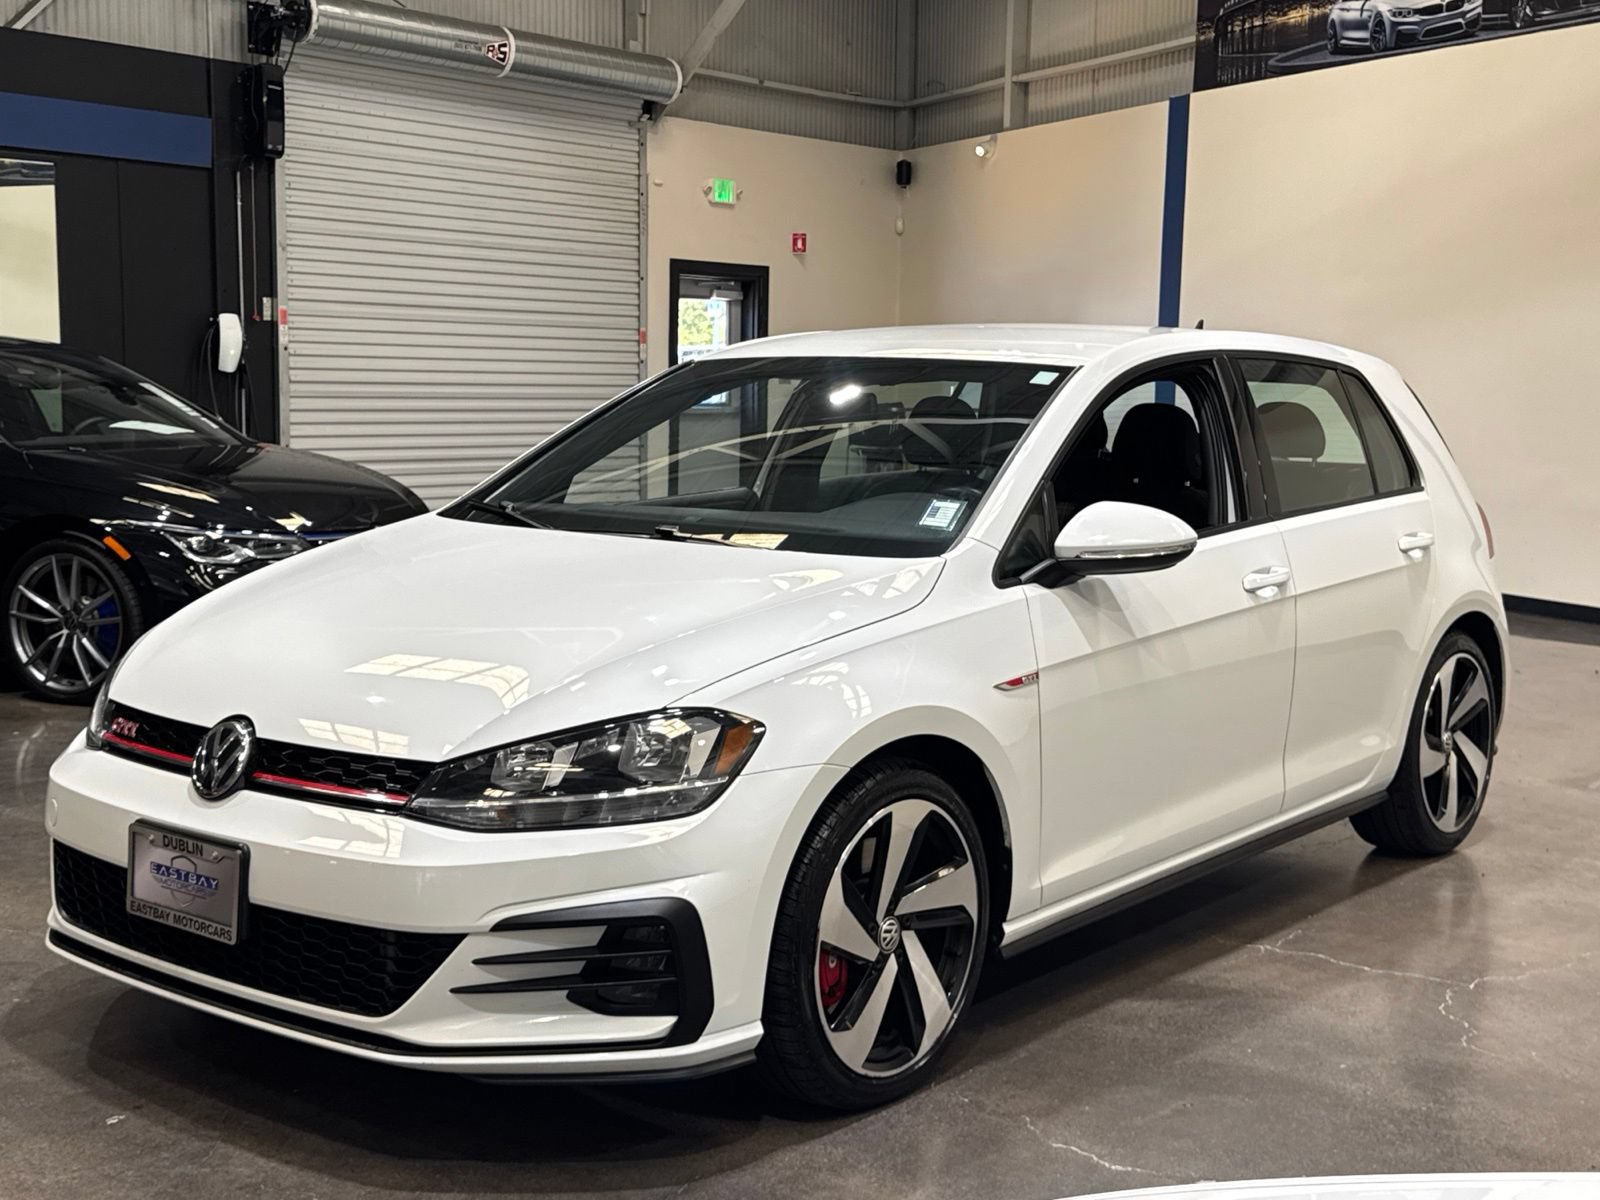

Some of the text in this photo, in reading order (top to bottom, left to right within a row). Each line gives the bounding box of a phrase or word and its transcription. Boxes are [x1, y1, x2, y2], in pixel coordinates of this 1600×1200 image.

[162, 835, 204, 857] DUBLIN
[151, 862, 218, 889] EASTBAY
[130, 901, 233, 942] EASTBAY MOTORCARS
